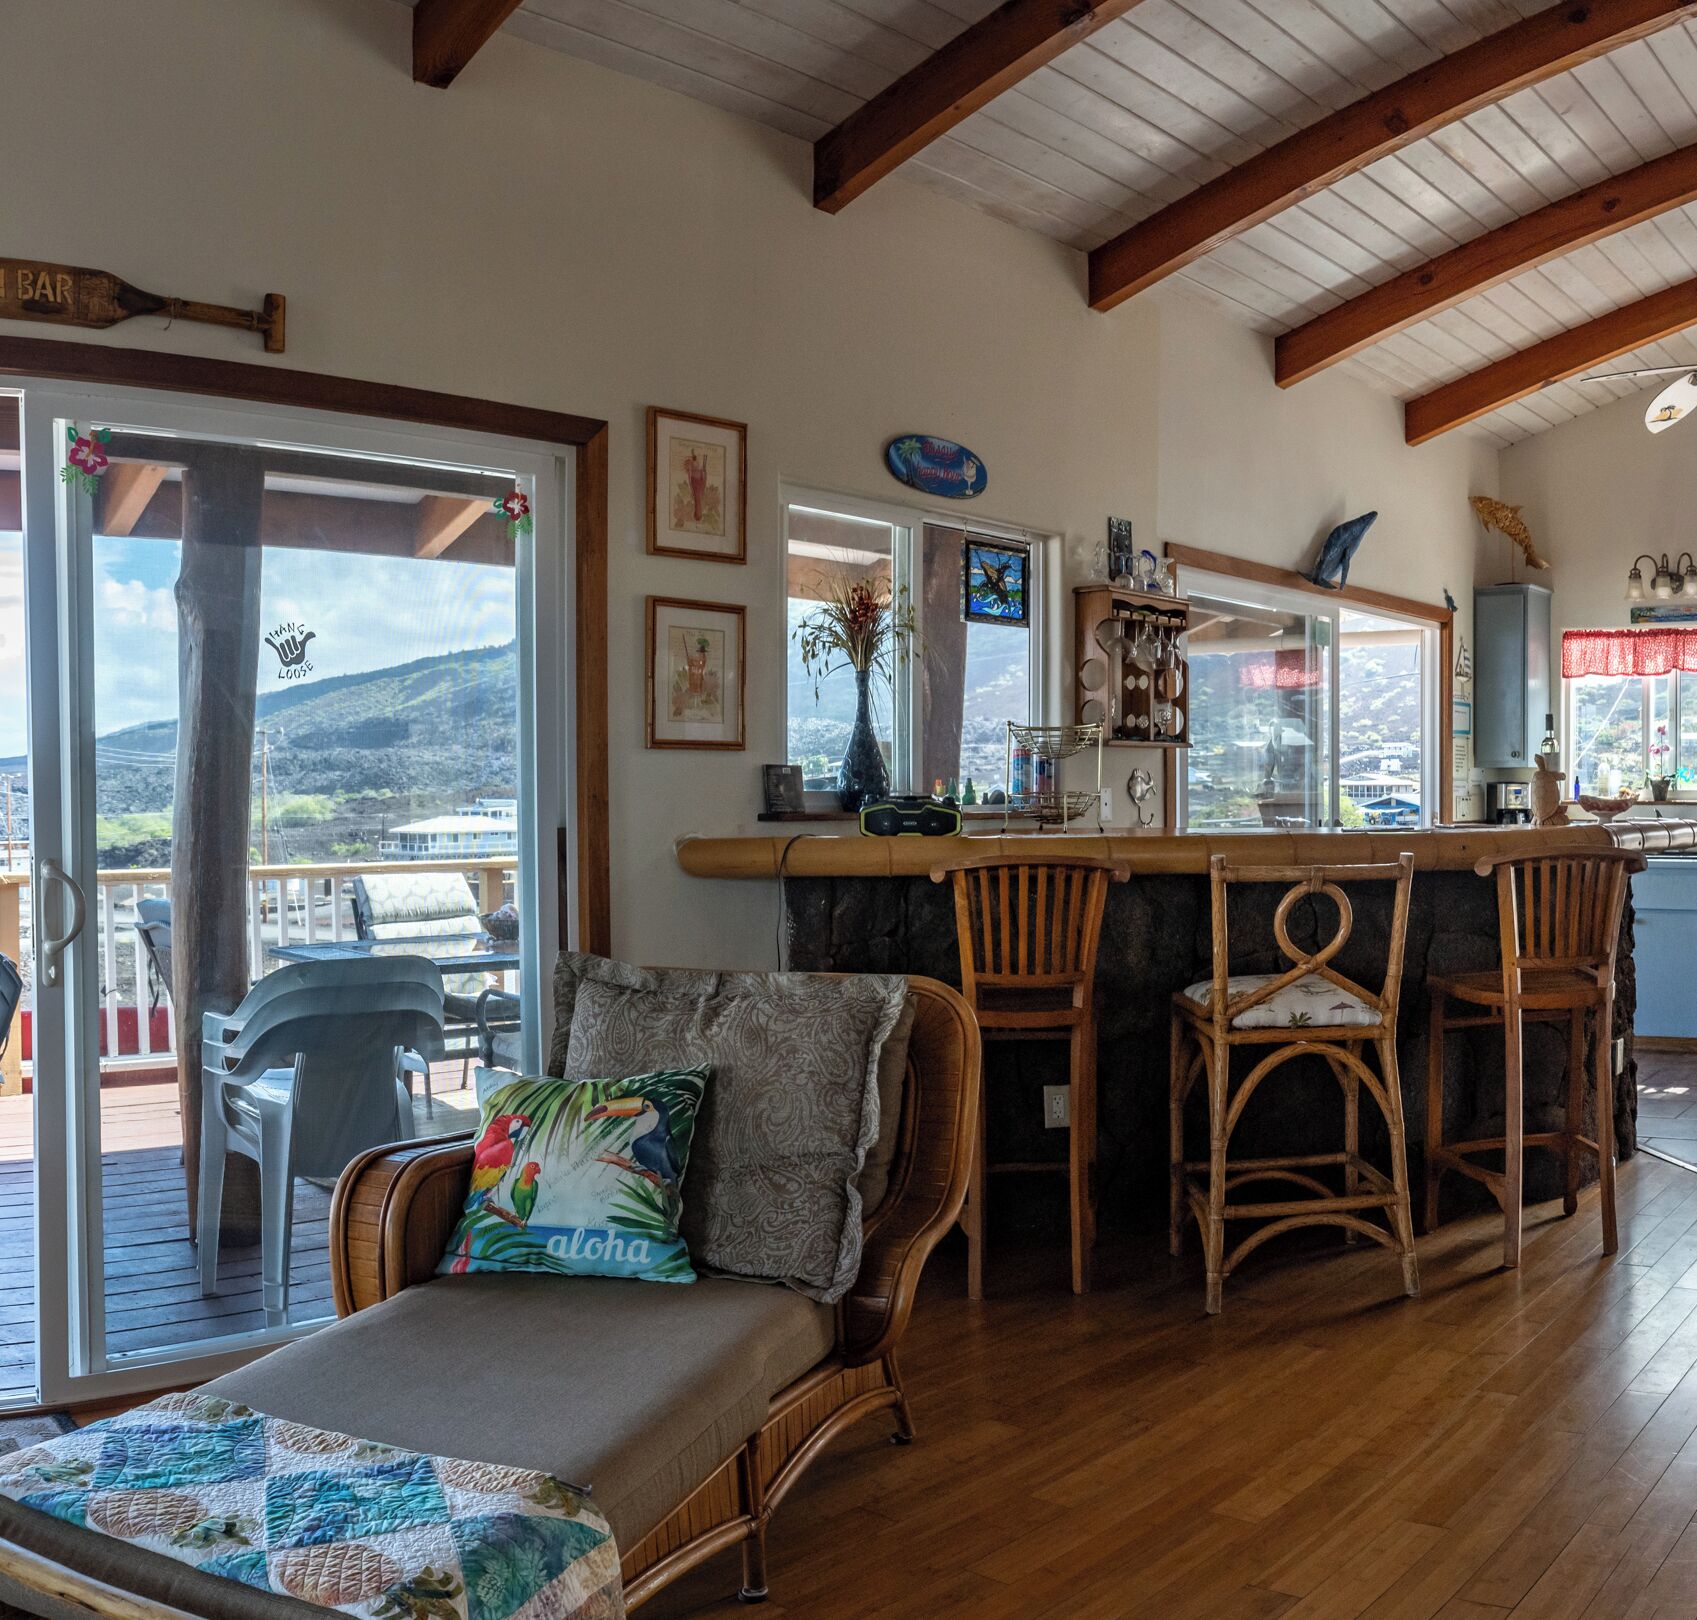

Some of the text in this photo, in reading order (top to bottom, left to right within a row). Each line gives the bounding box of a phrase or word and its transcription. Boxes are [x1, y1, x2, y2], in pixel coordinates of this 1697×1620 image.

[17, 269, 73, 304] BAR
[269, 622, 304, 640] HANG
[278, 660, 313, 679] LOOSE
[546, 1227, 651, 1264] aloha
